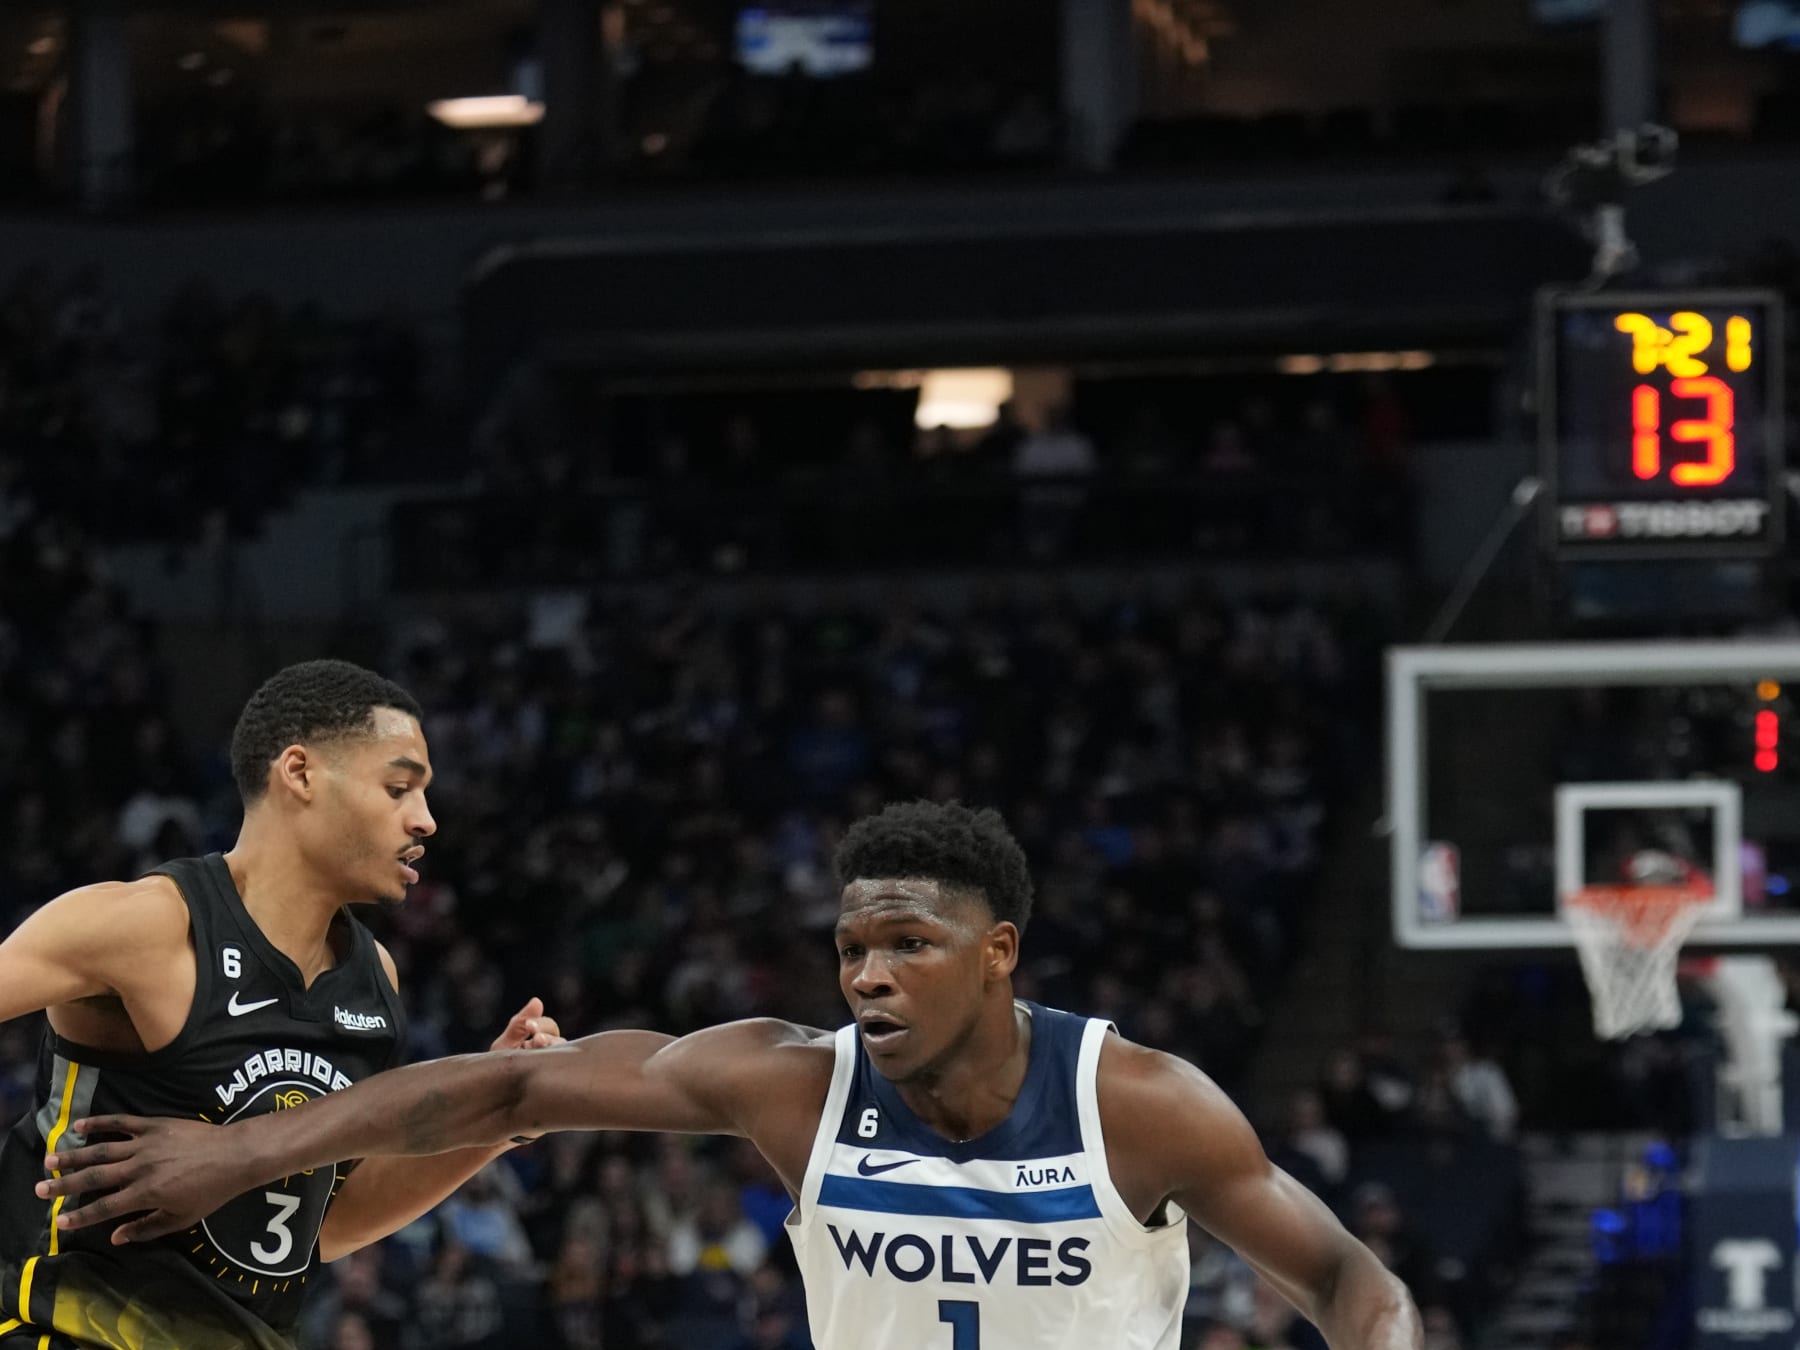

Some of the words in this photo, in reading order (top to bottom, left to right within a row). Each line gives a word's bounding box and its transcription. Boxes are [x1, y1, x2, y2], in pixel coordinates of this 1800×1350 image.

[1632, 376, 1735, 487] 13
[222, 947, 242, 979] 6
[334, 1004, 387, 1029] Rakuten
[215, 1048, 353, 1106] WARRIOR
[857, 1108, 879, 1138] 6
[250, 1191, 300, 1265] 3
[827, 1223, 1092, 1286] WOLVES
